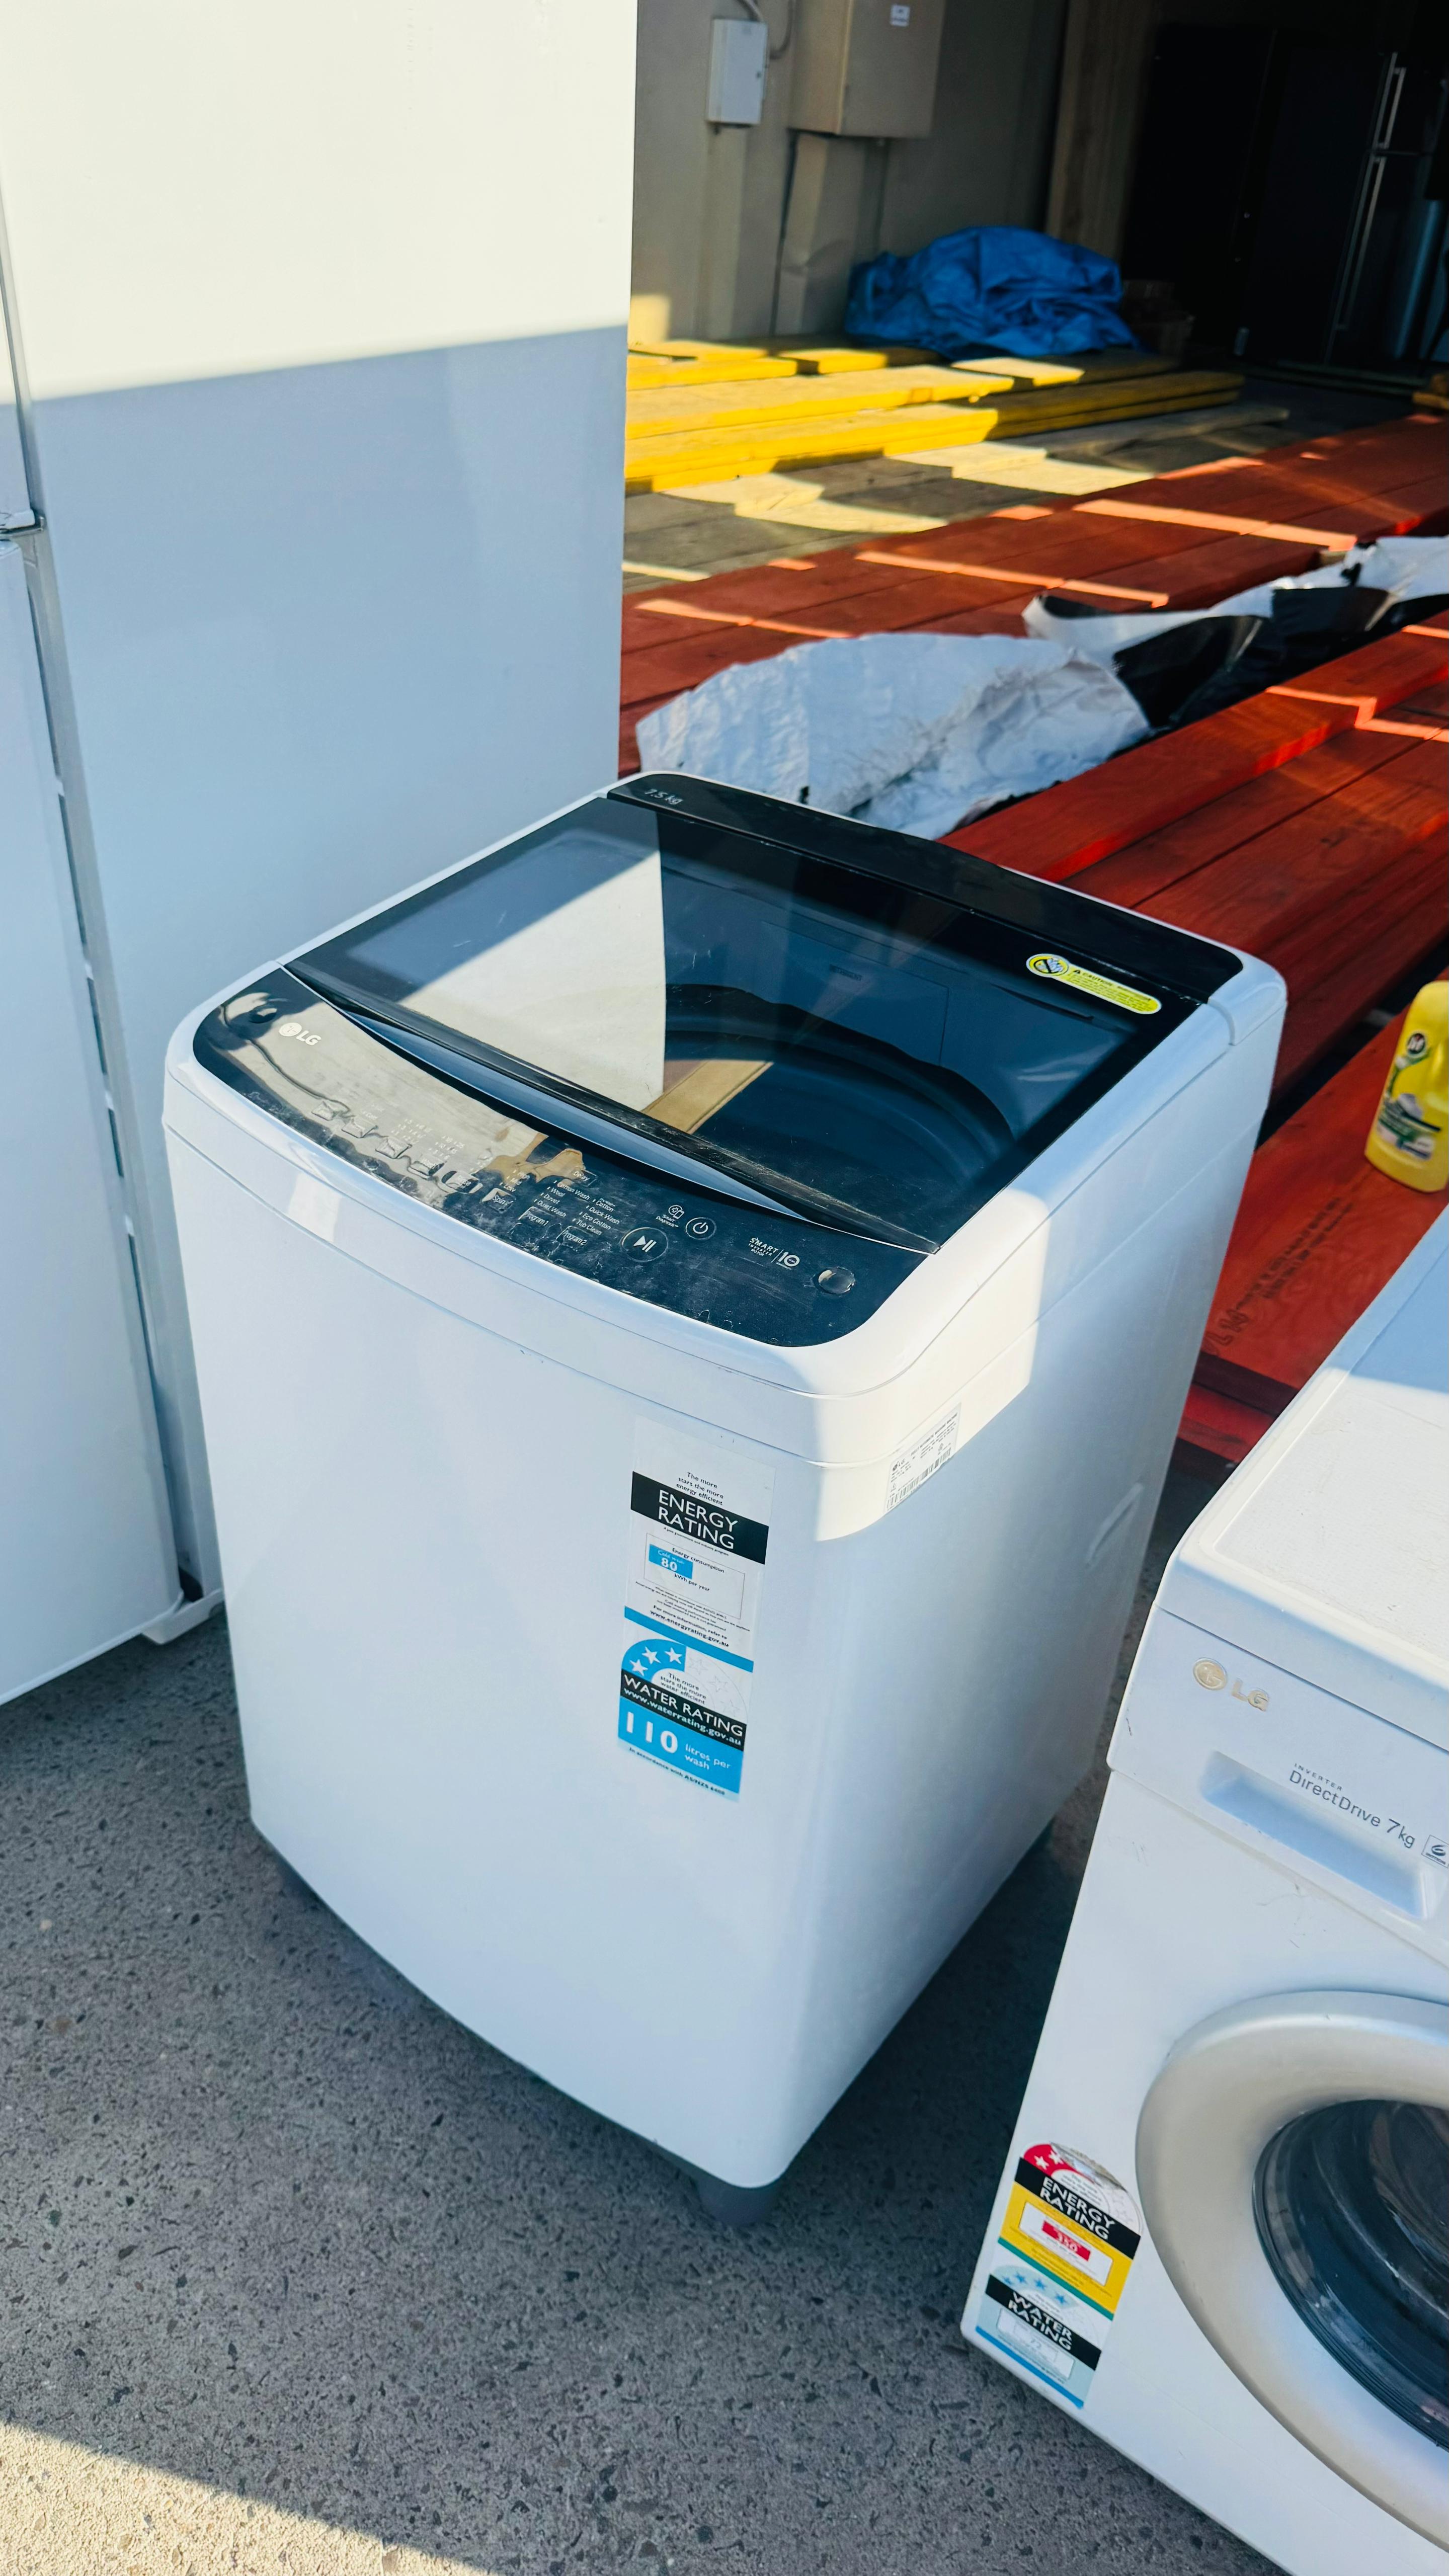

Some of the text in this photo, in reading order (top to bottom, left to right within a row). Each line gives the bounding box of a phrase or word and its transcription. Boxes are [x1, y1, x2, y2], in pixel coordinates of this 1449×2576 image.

[645, 789, 683, 805] 7.5 kg
[296, 1030, 321, 1045] LG
[575, 1189, 590, 1200] Wash
[550, 1206, 567, 1217] Wash
[589, 1206, 620, 1225] Quick Wash
[596, 1200, 614, 1212] Cotton
[576, 1219, 602, 1235] Tub Clean
[582, 1213, 611, 1230] Eco Cotton
[750, 1238, 779, 1253] SMART
[778, 1251, 800, 1267] 10
[678, 1477, 693, 1486] stars
[706, 1489, 723, 1499] more
[687, 1472, 717, 1488] The more
[676, 1484, 723, 1505] energy efficient
[659, 1489, 738, 1533] ENERGY
[658, 1506, 734, 1549] RATING
[661, 1557, 678, 1571] 80
[672, 1548, 725, 1573] Energy consumption
[674, 1573, 687, 1582] kWh
[650, 1610, 729, 1647] www.energyrating.gov.au
[661, 1676, 675, 1685] stars
[689, 1689, 706, 1699] more
[669, 1672, 699, 1691] The more
[661, 1682, 705, 1705] water efficient
[1231, 1677, 1270, 1712] LG
[624, 1673, 744, 1737] WATER RATING
[623, 1687, 742, 1746] www.waterrating.gov.au
[626, 1711, 678, 1754] 110
[684, 1754, 710, 1770] wash
[685, 1743, 731, 1768] litres per
[1294, 1762, 1343, 1791] INVERTER
[1040, 2187, 1109, 2240] RATING
[1042, 2177, 1115, 2229] ENERGY
[1008, 2299, 1073, 2351] RATING
[1013, 2291, 1072, 2342] WATER
